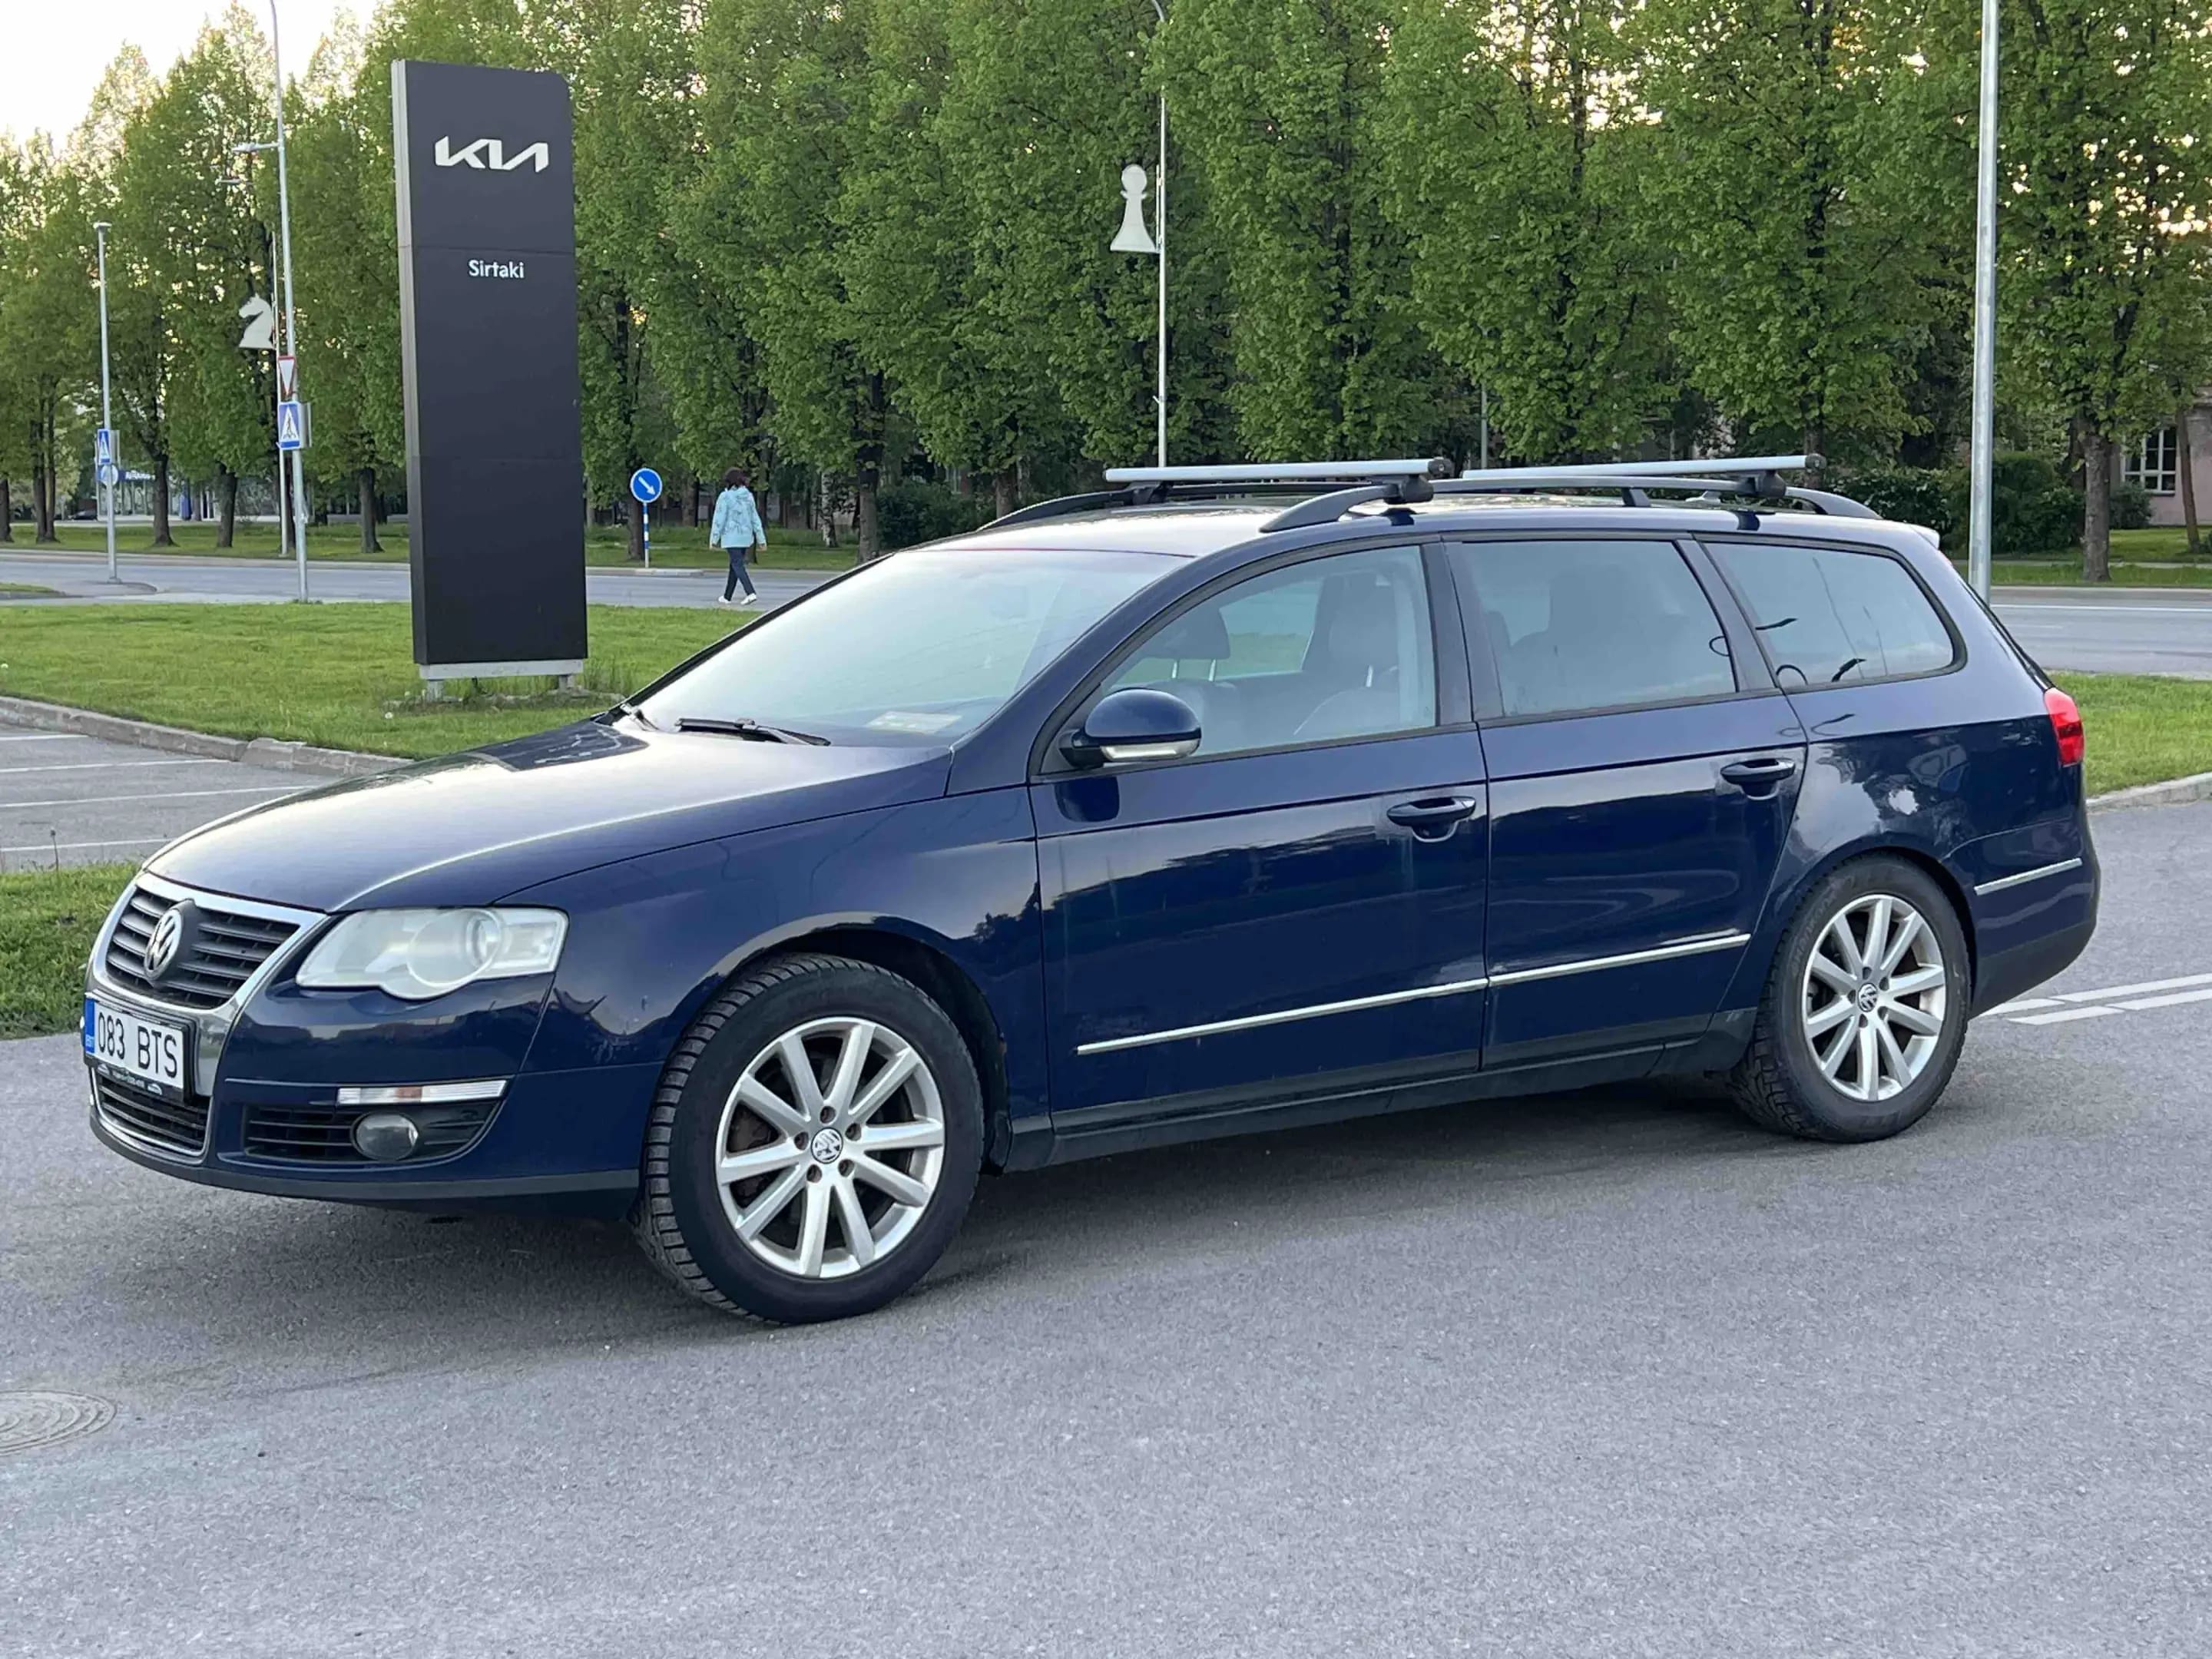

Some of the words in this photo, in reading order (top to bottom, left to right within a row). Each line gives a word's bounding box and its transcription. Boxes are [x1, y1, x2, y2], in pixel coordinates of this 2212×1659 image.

[435, 135, 549, 173] KIA
[469, 260, 525, 279] Sirtaki
[98, 1012, 125, 1060] 083
[137, 1025, 177, 1078] BTS
